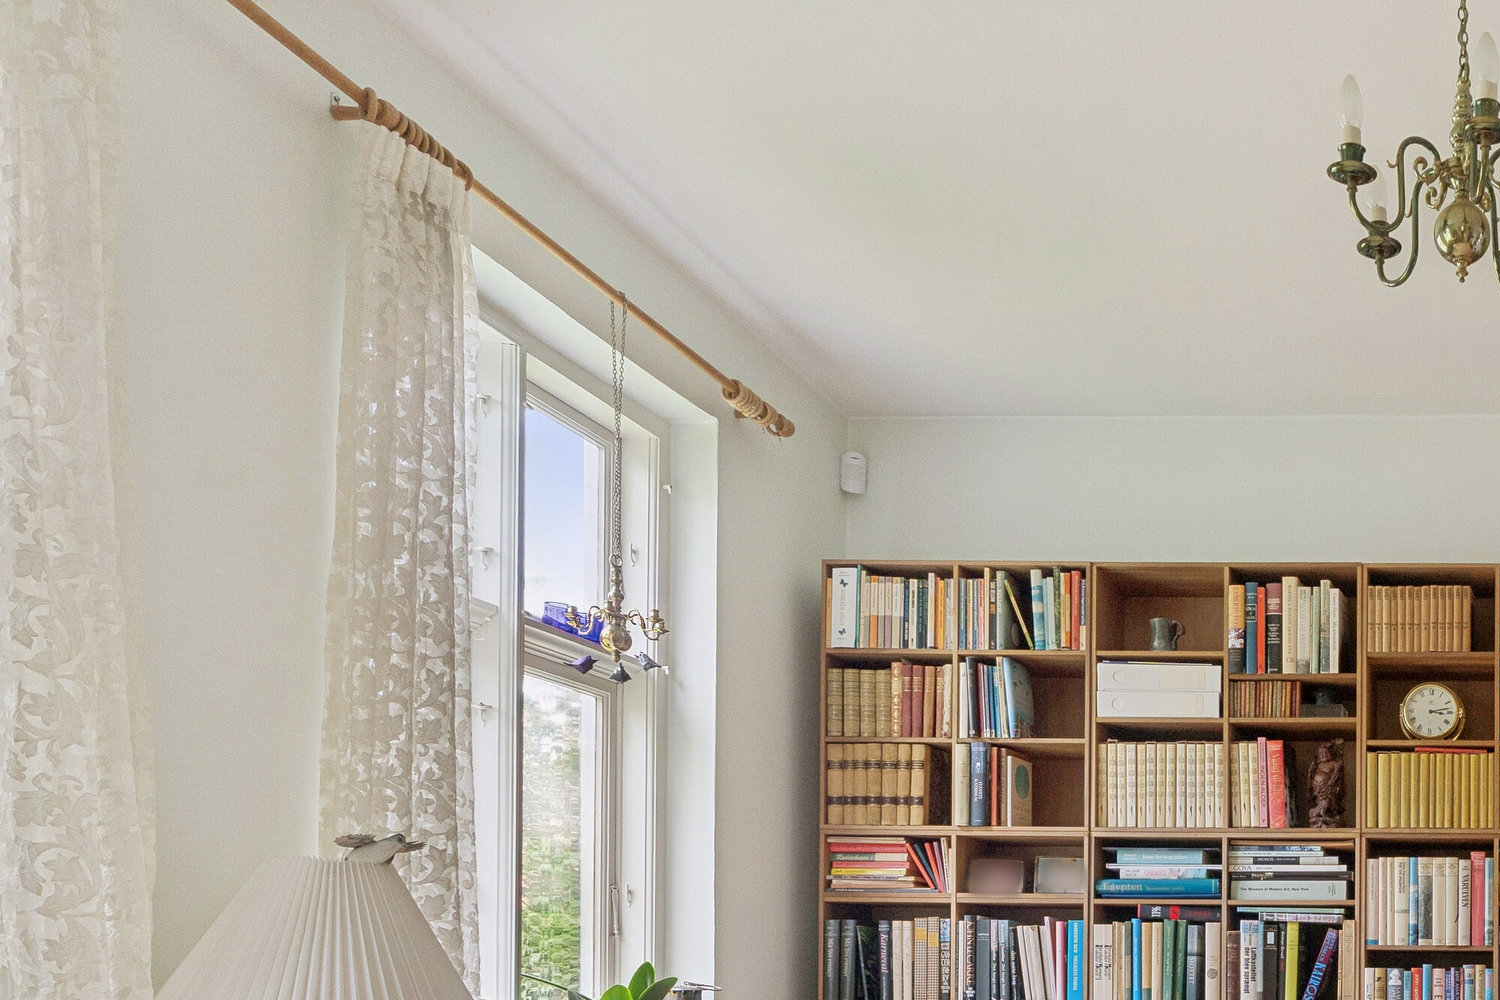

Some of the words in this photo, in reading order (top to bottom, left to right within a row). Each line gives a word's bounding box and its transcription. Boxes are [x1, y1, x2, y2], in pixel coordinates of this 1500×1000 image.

[1101, 881, 1142, 892] Egypten
[966, 920, 975, 945] JOHN
[880, 934, 889, 973] Karneval
[1303, 962, 1327, 1000] KAIROS
